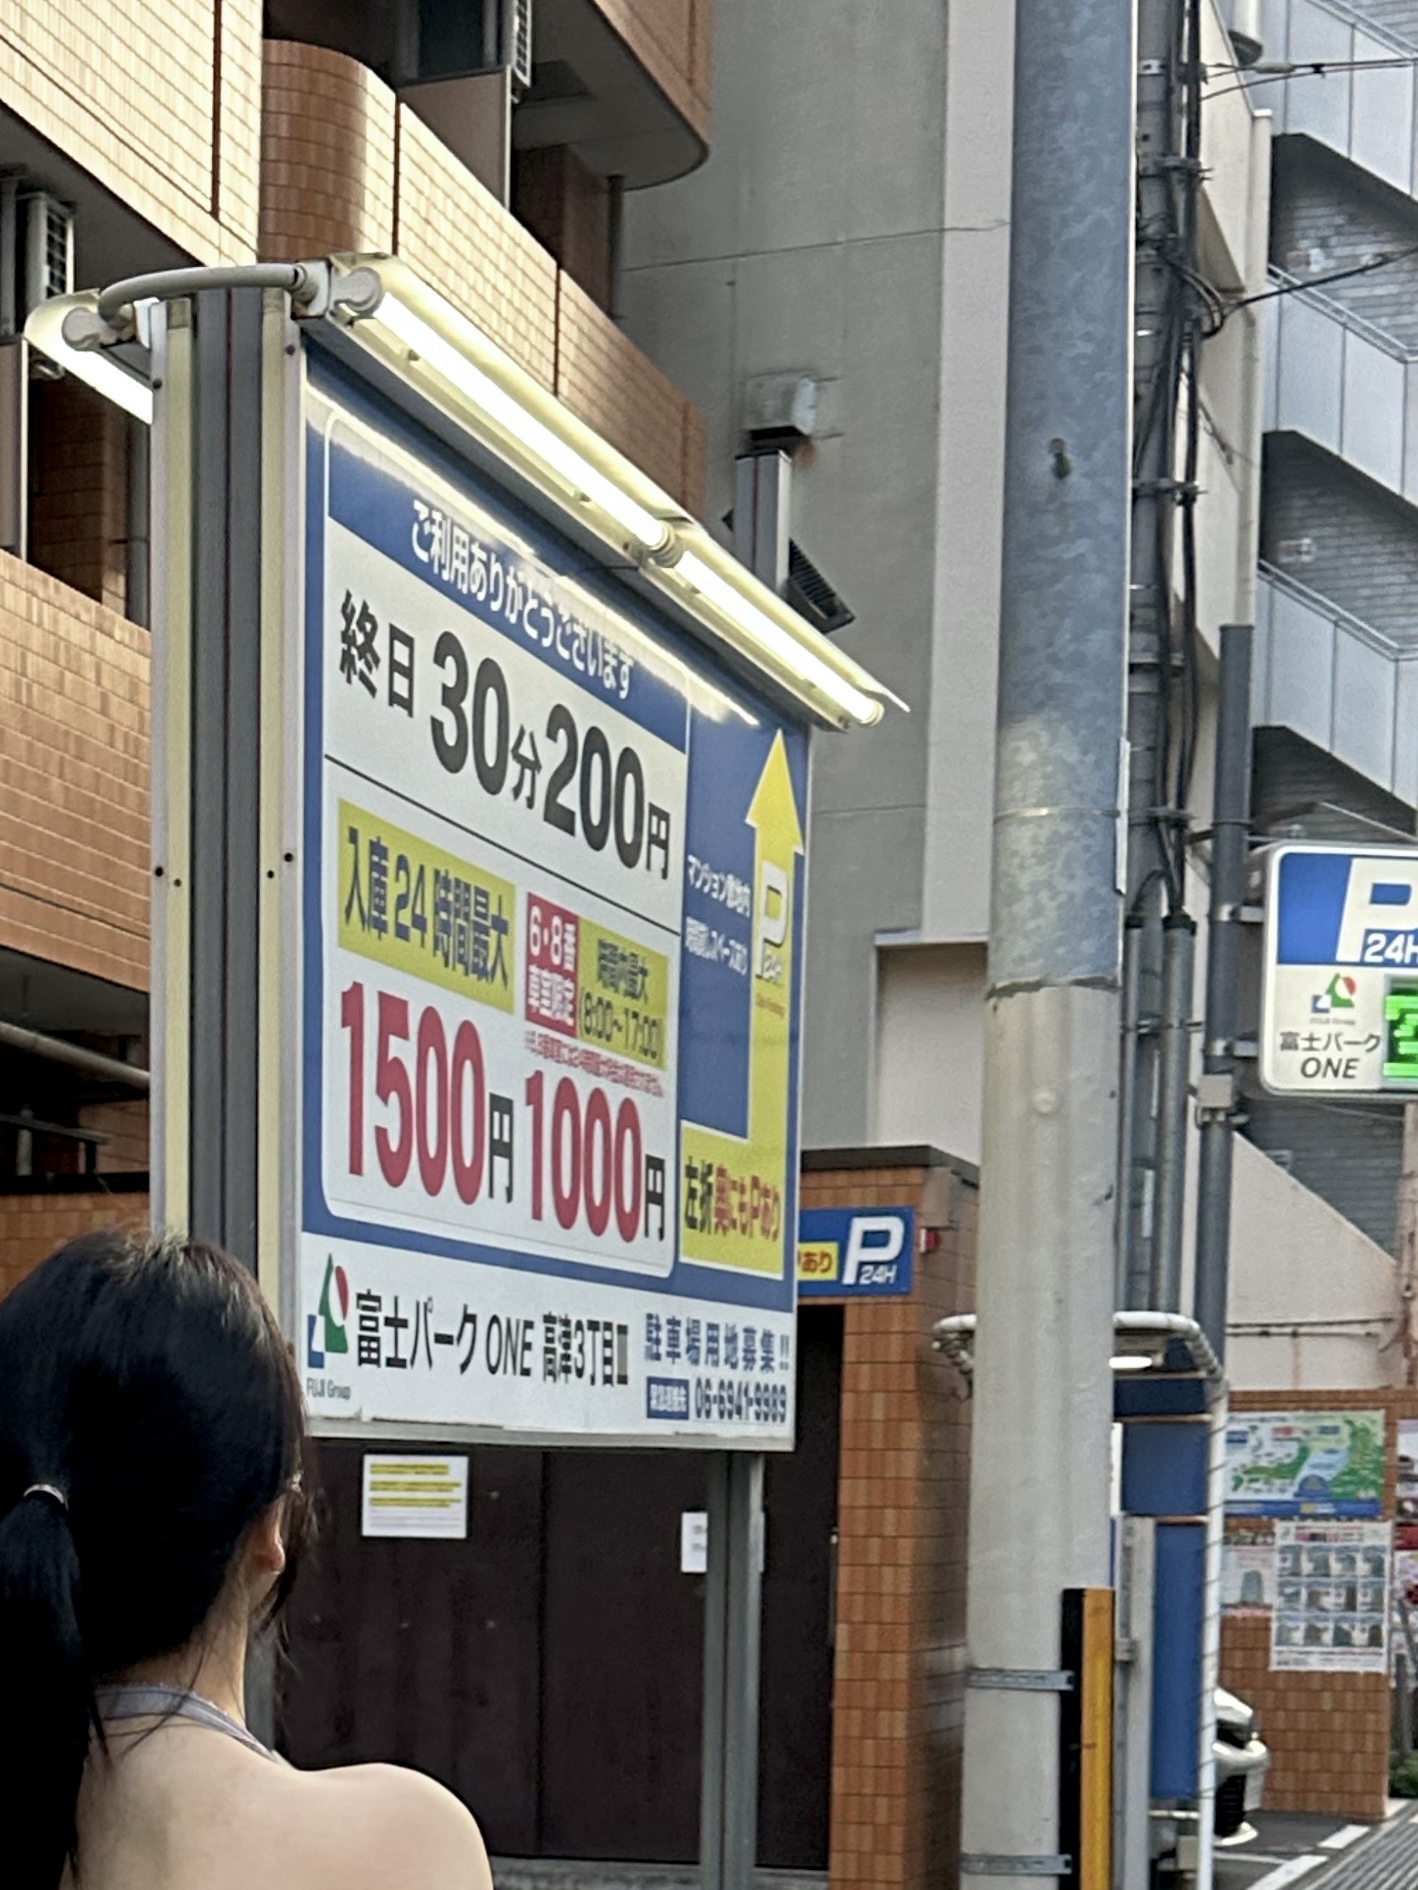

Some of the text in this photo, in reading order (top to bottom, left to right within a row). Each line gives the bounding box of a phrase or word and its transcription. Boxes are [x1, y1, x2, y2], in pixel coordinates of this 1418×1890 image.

[412, 500, 634, 699] ご利用ありがとうございます
[345, 826, 509, 989] 入庫24時間最大
[1280, 1031, 1381, 1053] 富士パーク
[1300, 1056, 1360, 1079] ONE
[341, 981, 514, 1205] 1500円
[525, 1069, 665, 1243] 1000円
[797, 1250, 834, 1274] あり
[842, 1216, 905, 1285] P
[355, 1289, 478, 1376] 富士パーク
[485, 1314, 535, 1377] ONE
